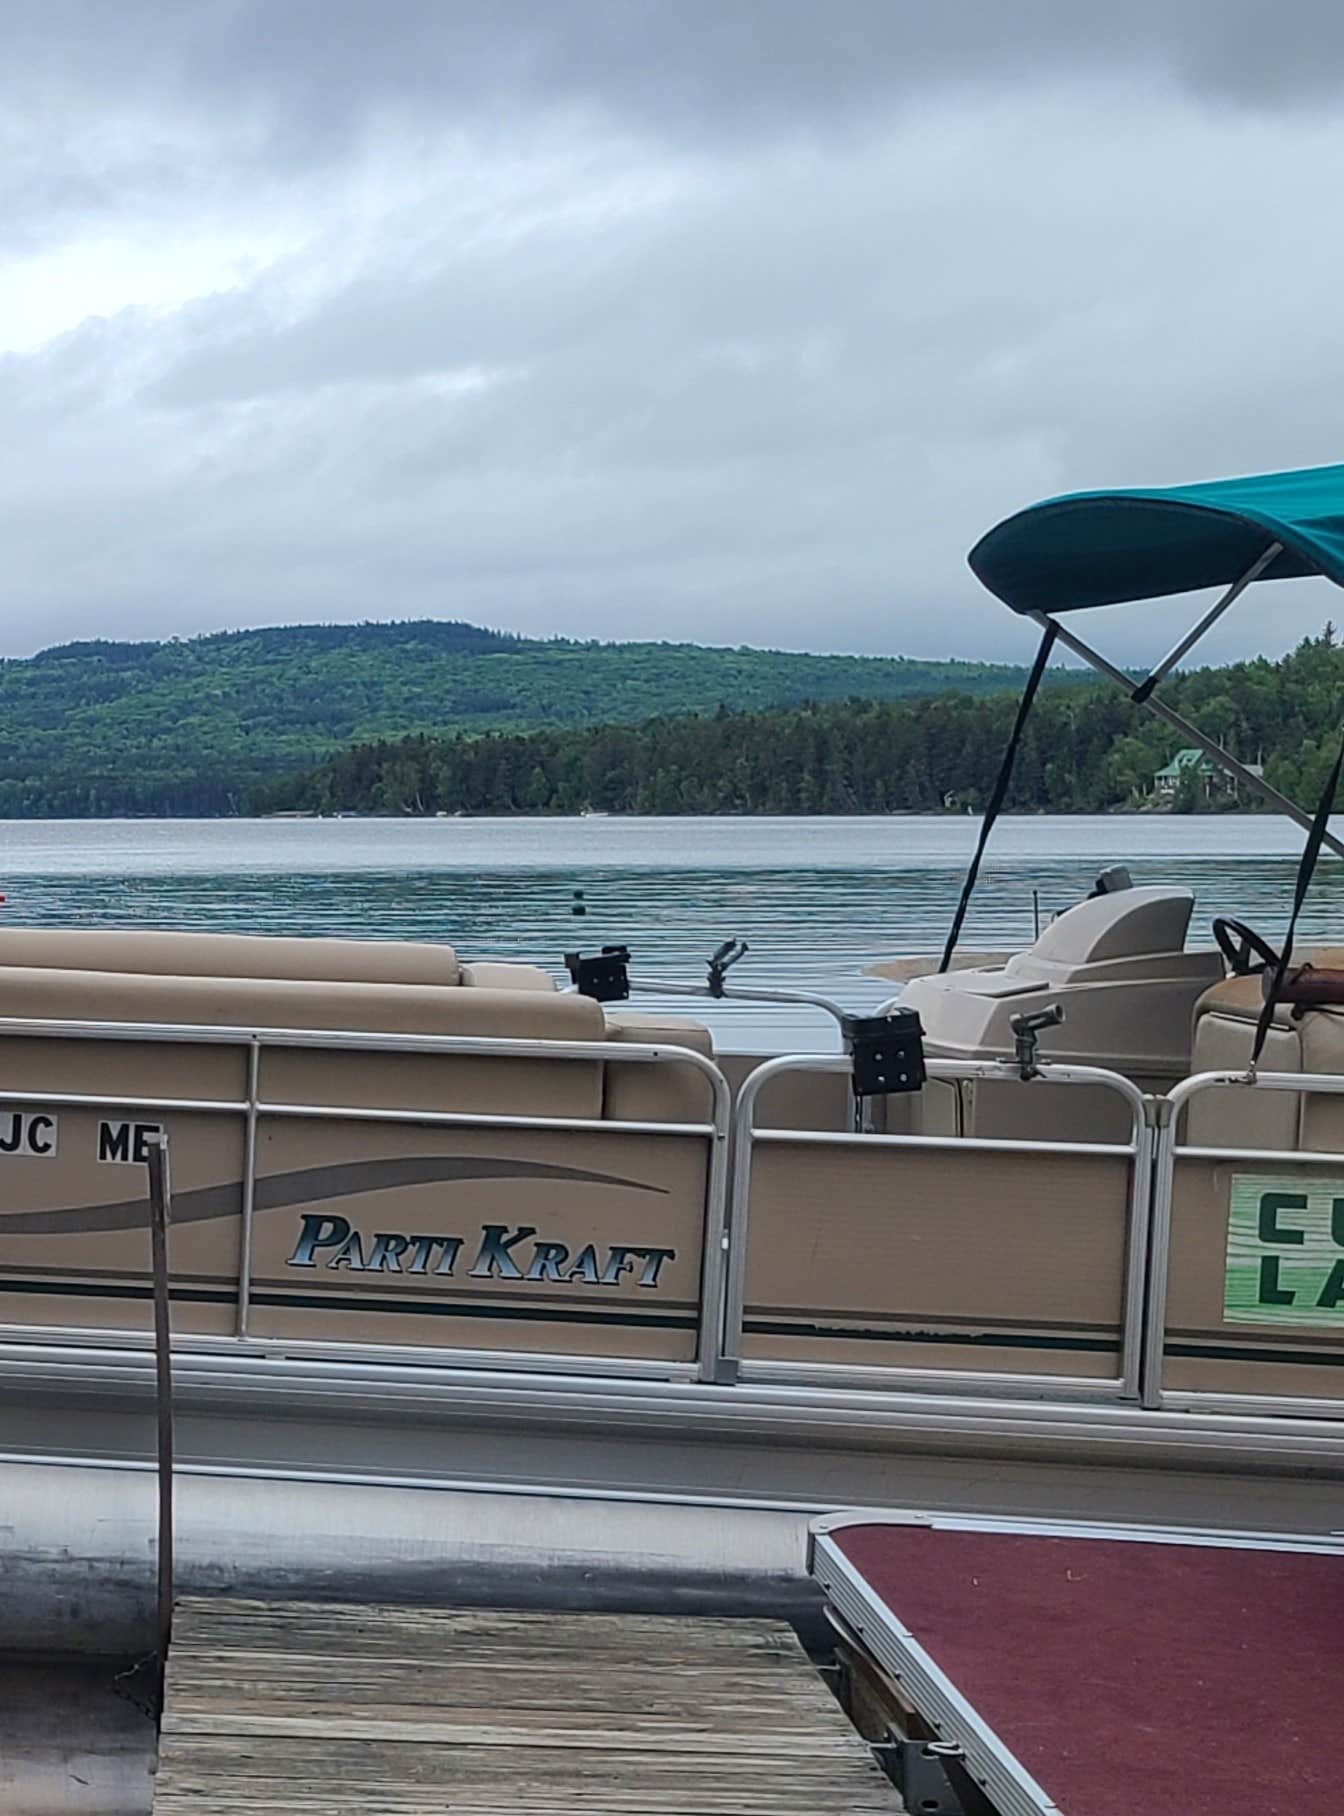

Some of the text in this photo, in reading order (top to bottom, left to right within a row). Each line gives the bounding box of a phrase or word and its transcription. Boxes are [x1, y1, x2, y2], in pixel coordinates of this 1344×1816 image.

[98, 1122, 160, 1163] ME
[287, 1213, 675, 1288] PARTI KRAFT
